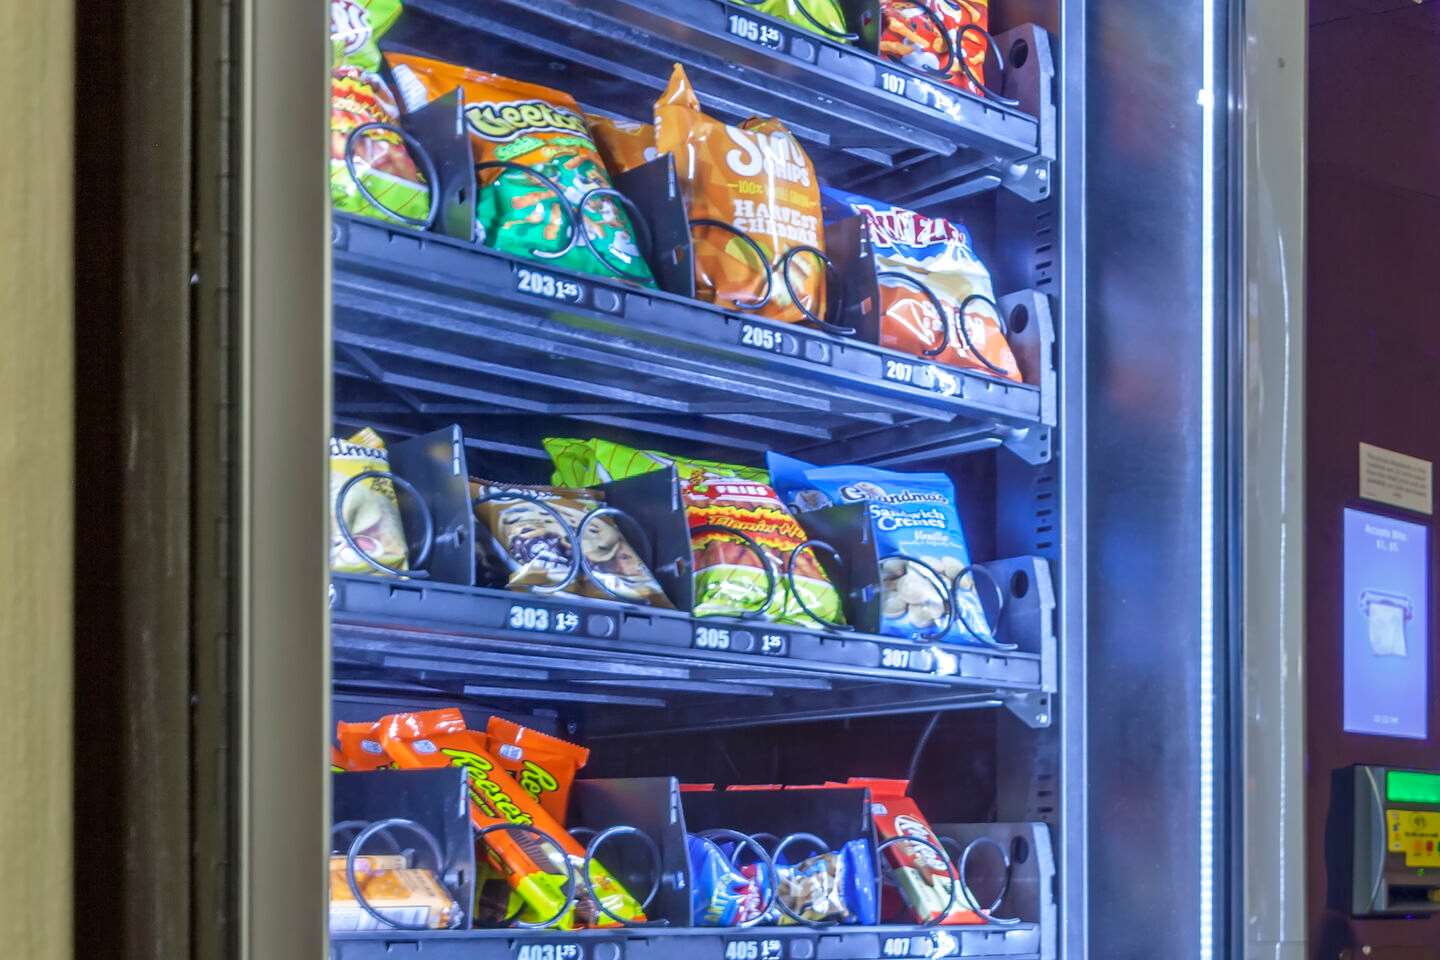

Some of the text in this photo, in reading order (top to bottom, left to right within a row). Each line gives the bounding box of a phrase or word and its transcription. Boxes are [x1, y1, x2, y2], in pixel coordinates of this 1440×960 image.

[729, 15, 758, 41] 105
[882, 72, 905, 95] 107
[517, 269, 555, 297] 203
[742, 325, 773, 349] 205
[886, 360, 912, 381] 207
[510, 606, 549, 631] 303
[696, 628, 729, 649] 305
[725, 940, 758, 960] 405
